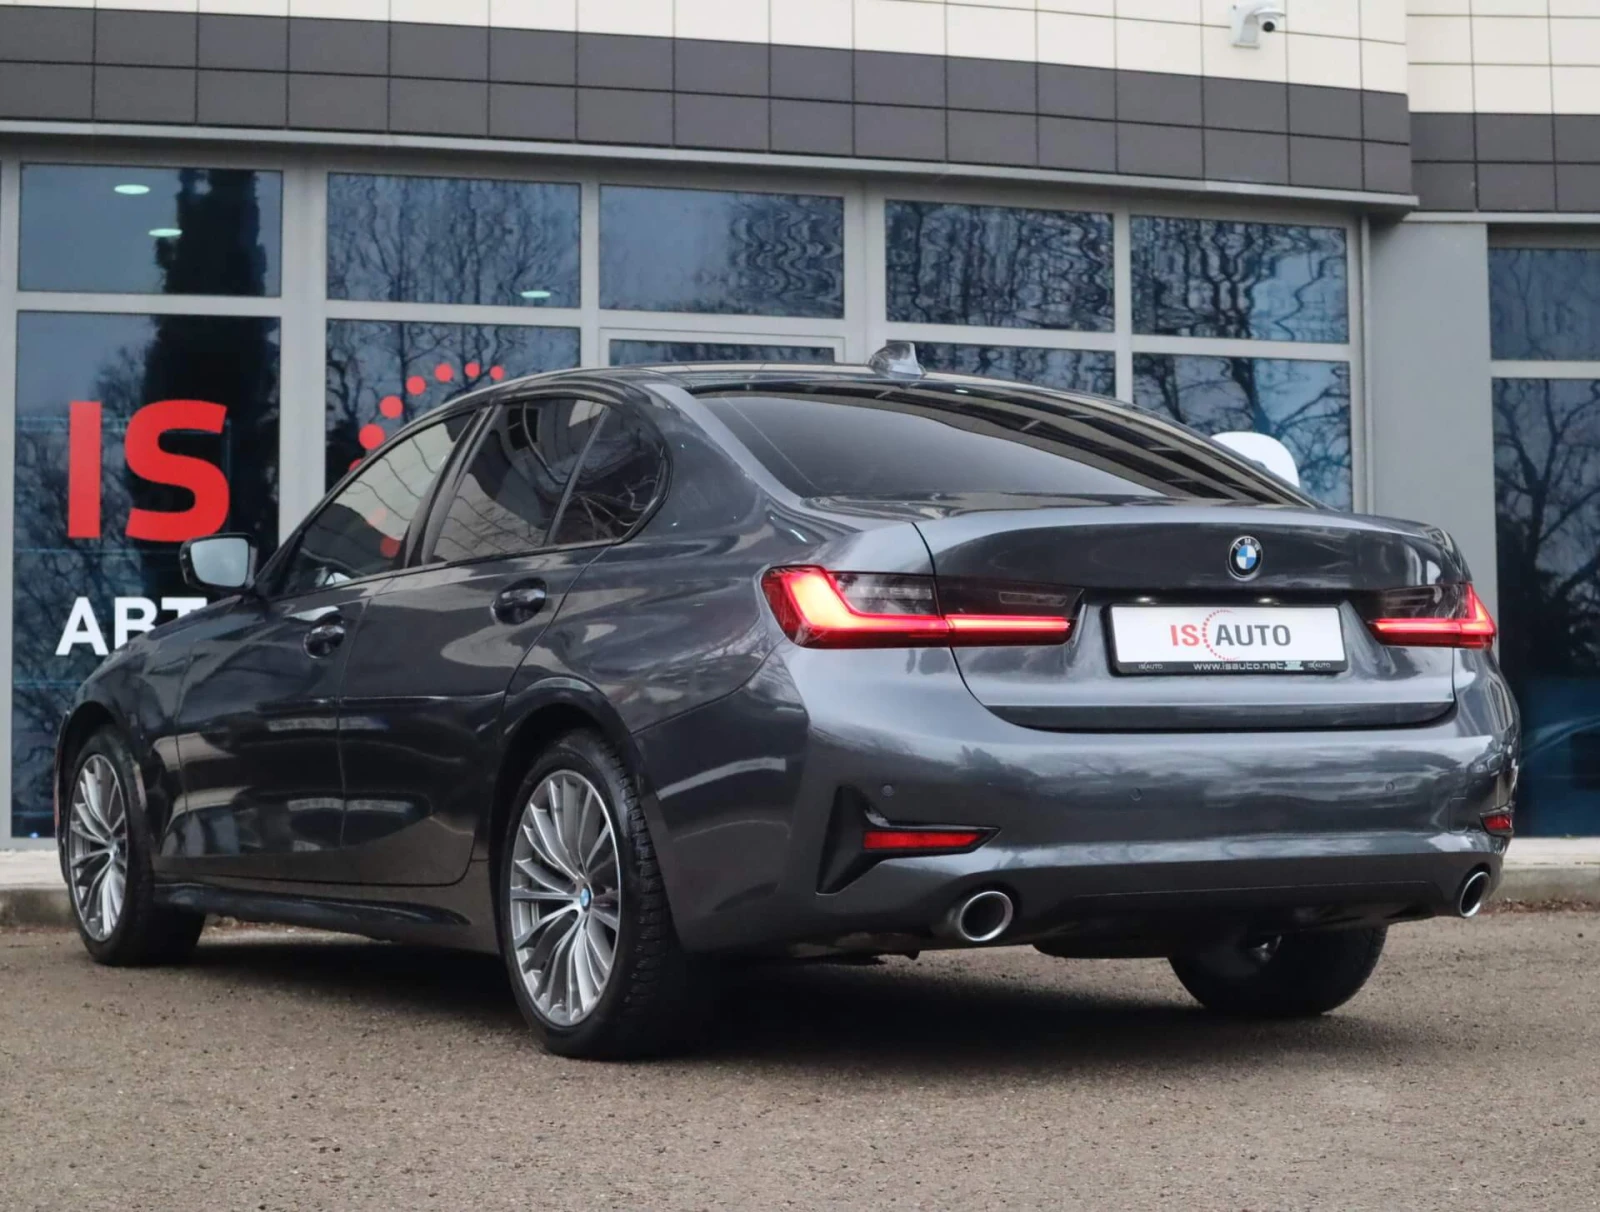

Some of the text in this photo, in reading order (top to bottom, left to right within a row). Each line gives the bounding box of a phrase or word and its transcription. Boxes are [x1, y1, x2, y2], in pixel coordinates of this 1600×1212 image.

[67, 399, 230, 541] IS
[1170, 624, 1292, 647] IS AUTO
[1193, 661, 1284, 670] www.isauto.net
